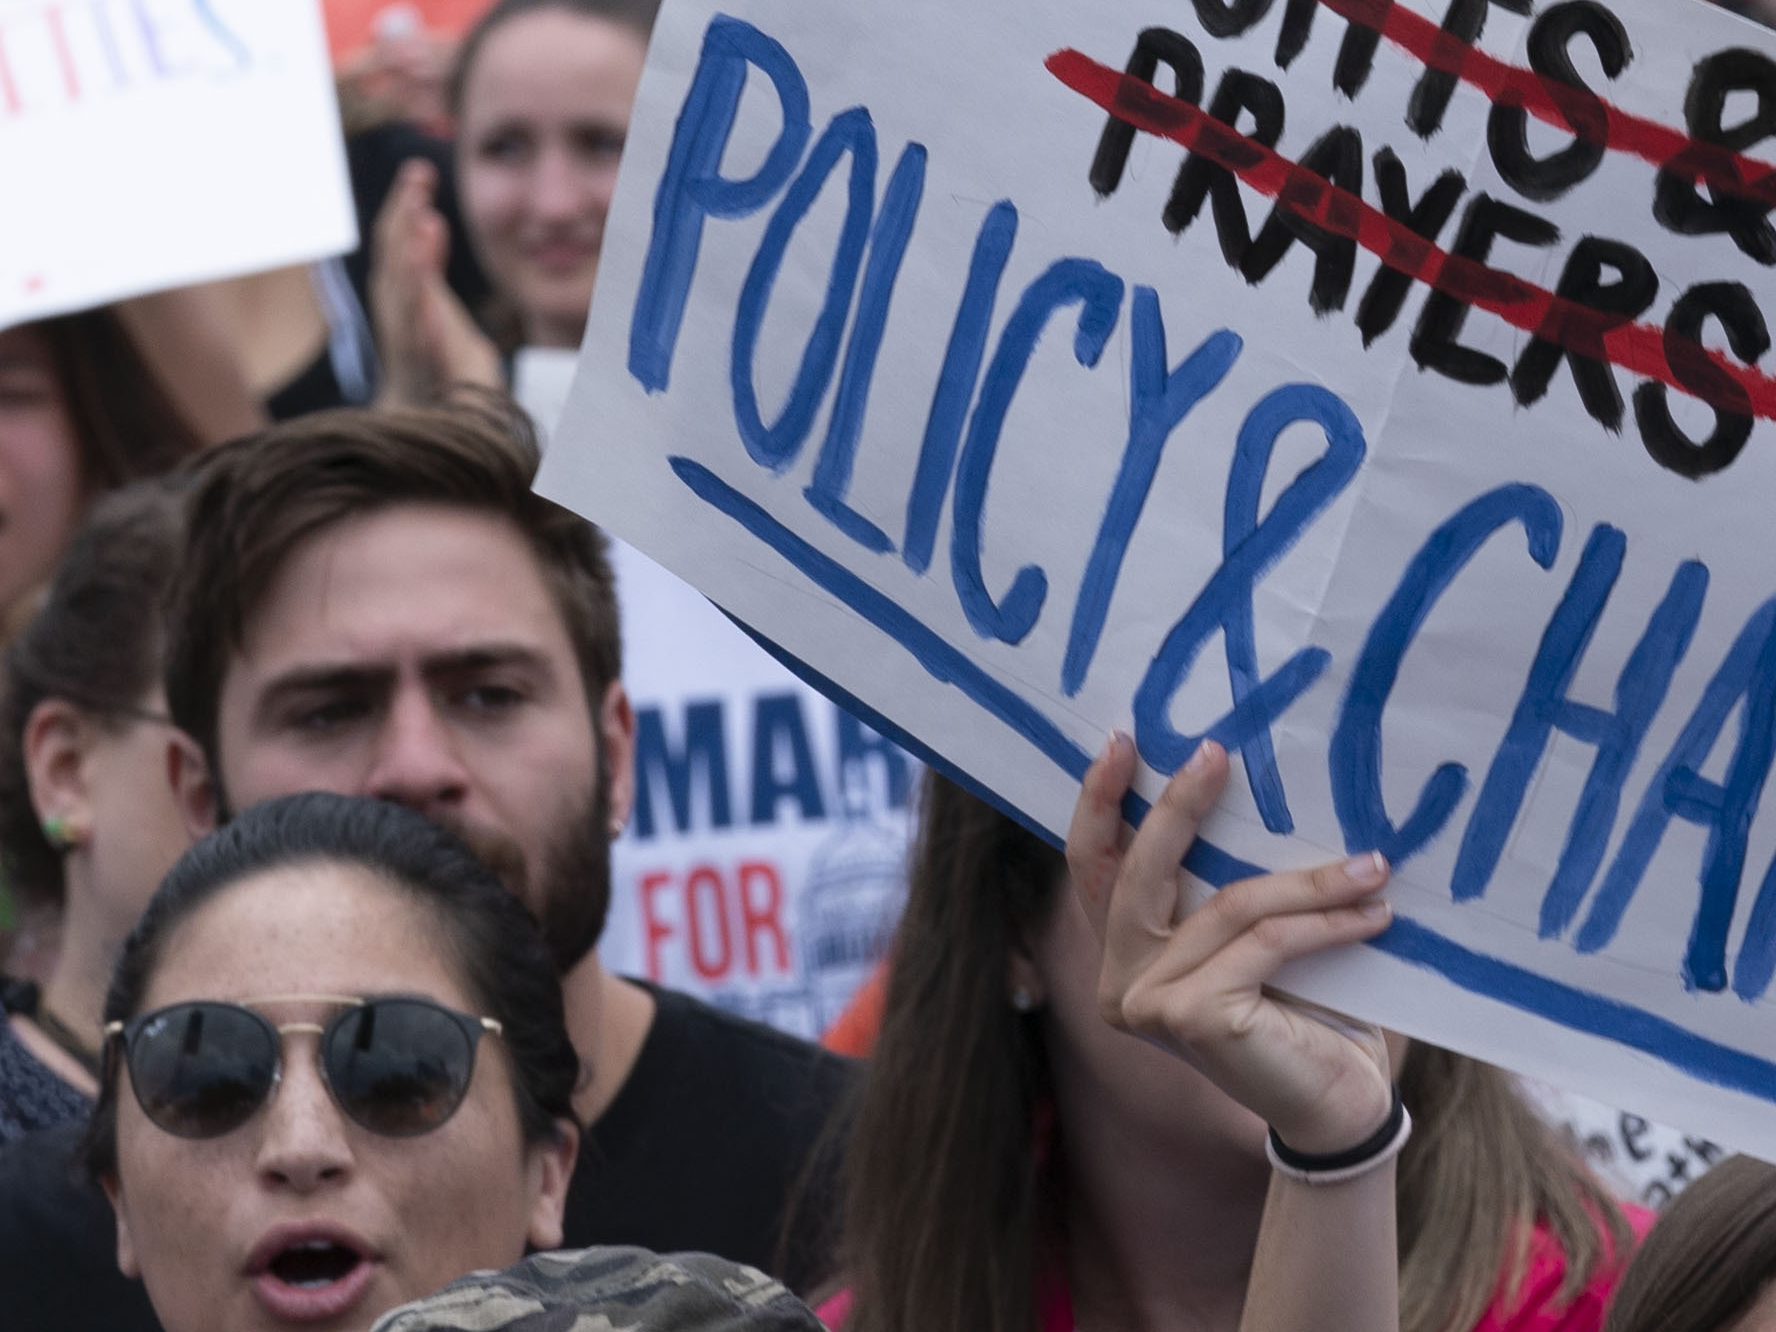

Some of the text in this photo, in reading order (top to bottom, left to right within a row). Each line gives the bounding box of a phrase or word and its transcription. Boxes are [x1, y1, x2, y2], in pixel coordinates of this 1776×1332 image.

[629, 14, 1243, 697] POLICY
[1133, 383, 1366, 834] &
[1089, 27, 1770, 479] PRAYERS
[635, 860, 792, 985] FOR
